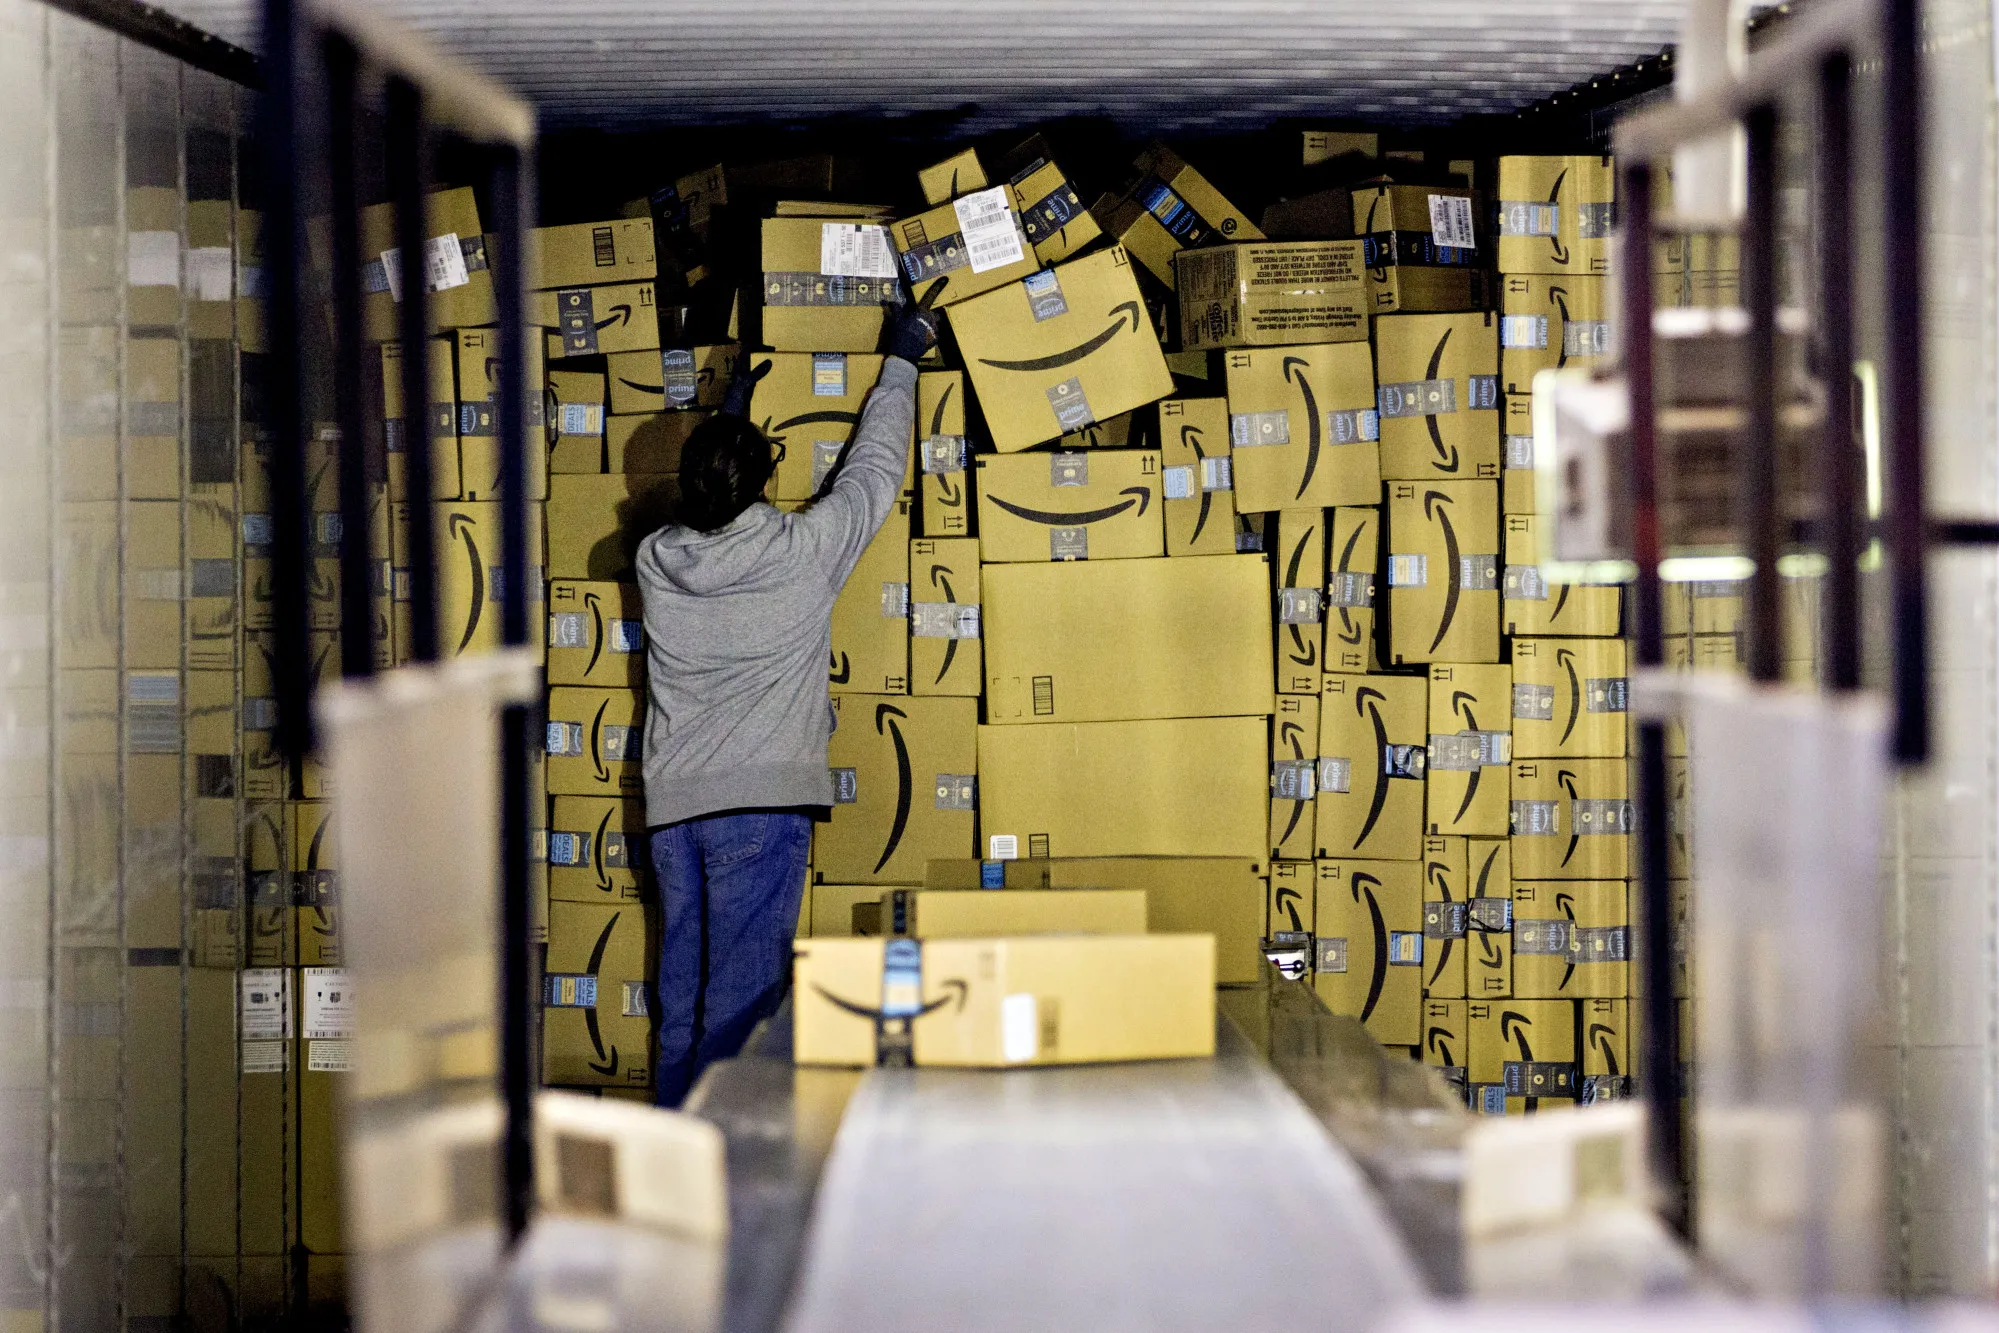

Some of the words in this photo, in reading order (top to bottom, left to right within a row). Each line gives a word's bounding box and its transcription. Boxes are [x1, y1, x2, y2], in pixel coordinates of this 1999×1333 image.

[1048, 198, 1066, 222] prime
[1171, 210, 1192, 233] prime
[903, 256, 918, 282] prime
[1038, 303, 1065, 318] prime
[664, 356, 690, 366] prime
[668, 384, 695, 394] prime
[1386, 388, 1396, 414] prime
[1480, 379, 1488, 406] prime
[1059, 403, 1085, 420] prime
[1338, 415, 1346, 442] prime
[1513, 438, 1522, 465] prime
[1463, 559, 1472, 588] prime
[1529, 568, 1538, 596] prime
[569, 616, 577, 644] prime
[1616, 682, 1625, 709] prime
[552, 725, 560, 750] DEALS
[1480, 735, 1490, 762] prime
[842, 772, 850, 799] prime
[1332, 762, 1340, 790] prime
[1531, 804, 1540, 832] prime
[562, 836, 570, 862] DEALS
[1452, 904, 1462, 932] prime
[1550, 924, 1558, 951] prime
[586, 978, 594, 1004] DEALS
